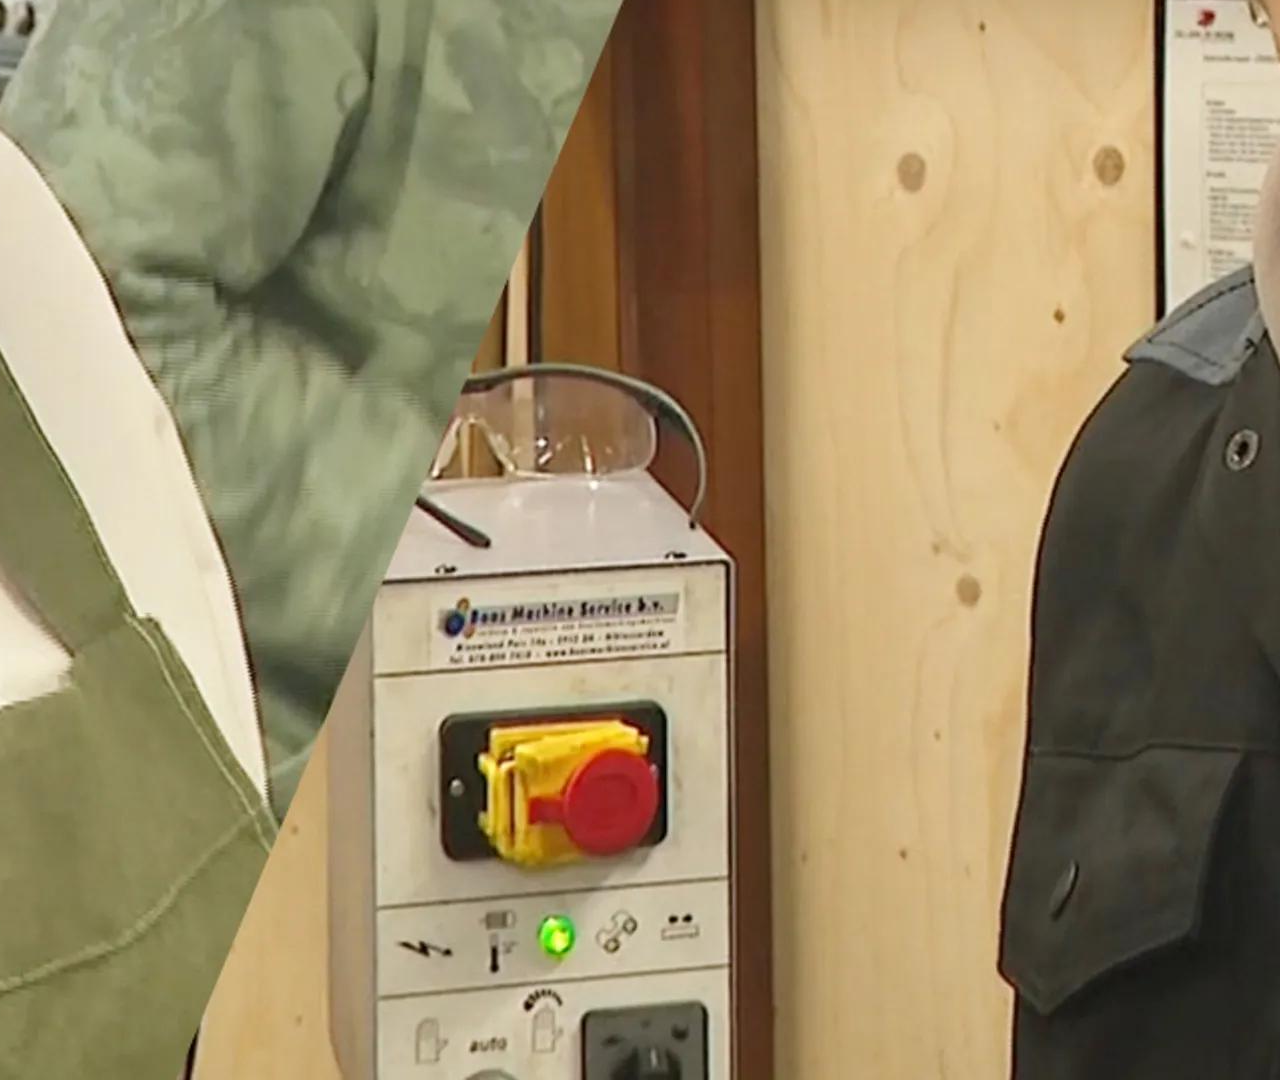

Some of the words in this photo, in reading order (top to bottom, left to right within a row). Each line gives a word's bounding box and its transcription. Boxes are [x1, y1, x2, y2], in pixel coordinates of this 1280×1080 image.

[511, 602, 574, 621] Machine
[581, 601, 632, 618] Service
[469, 1036, 507, 1053] auto
